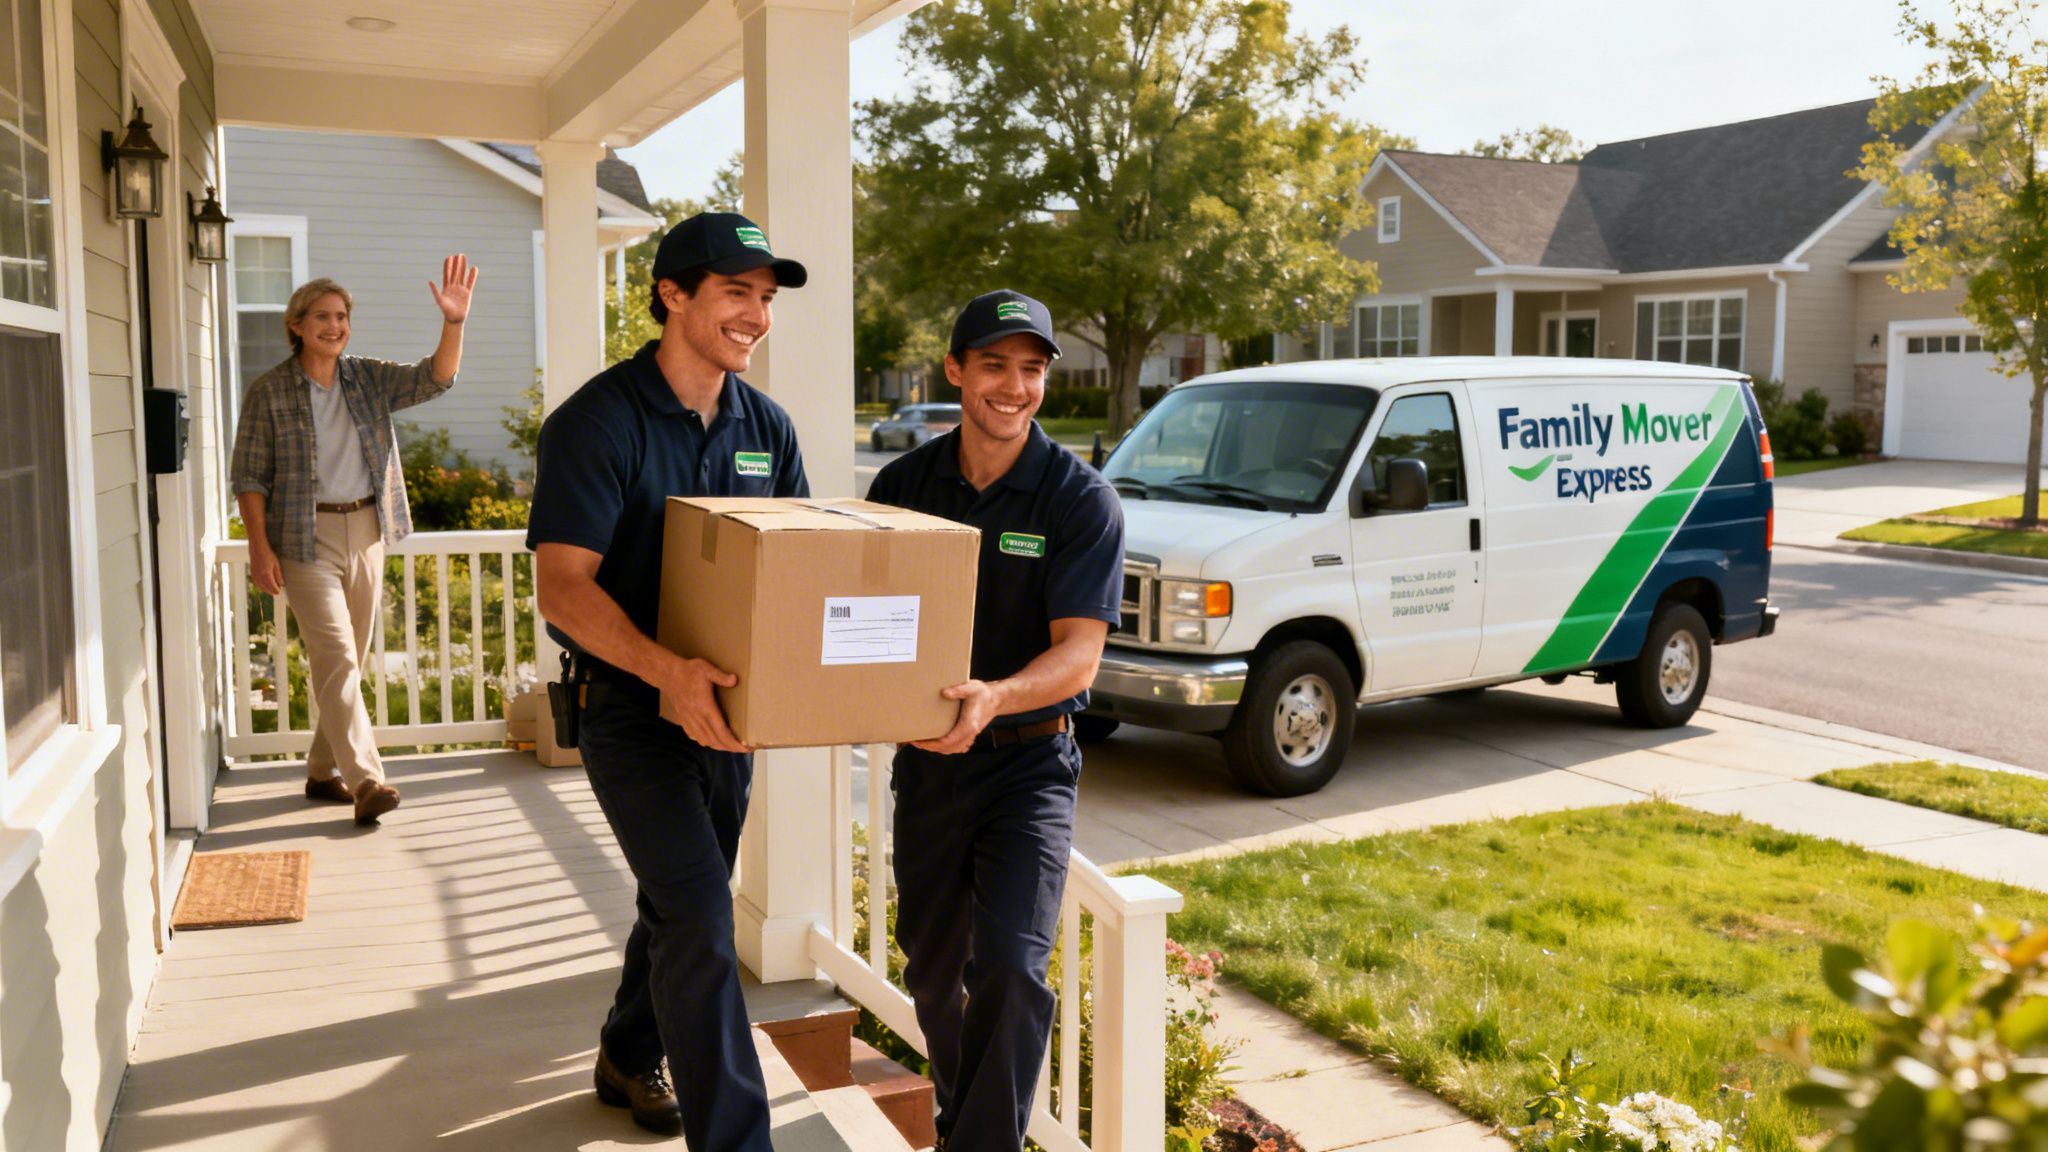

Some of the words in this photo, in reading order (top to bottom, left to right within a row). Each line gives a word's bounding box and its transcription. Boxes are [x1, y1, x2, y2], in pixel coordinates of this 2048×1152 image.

[1498, 402, 1613, 457] Family
[1621, 402, 1712, 445] Mover
[1557, 464, 1652, 503] Express
